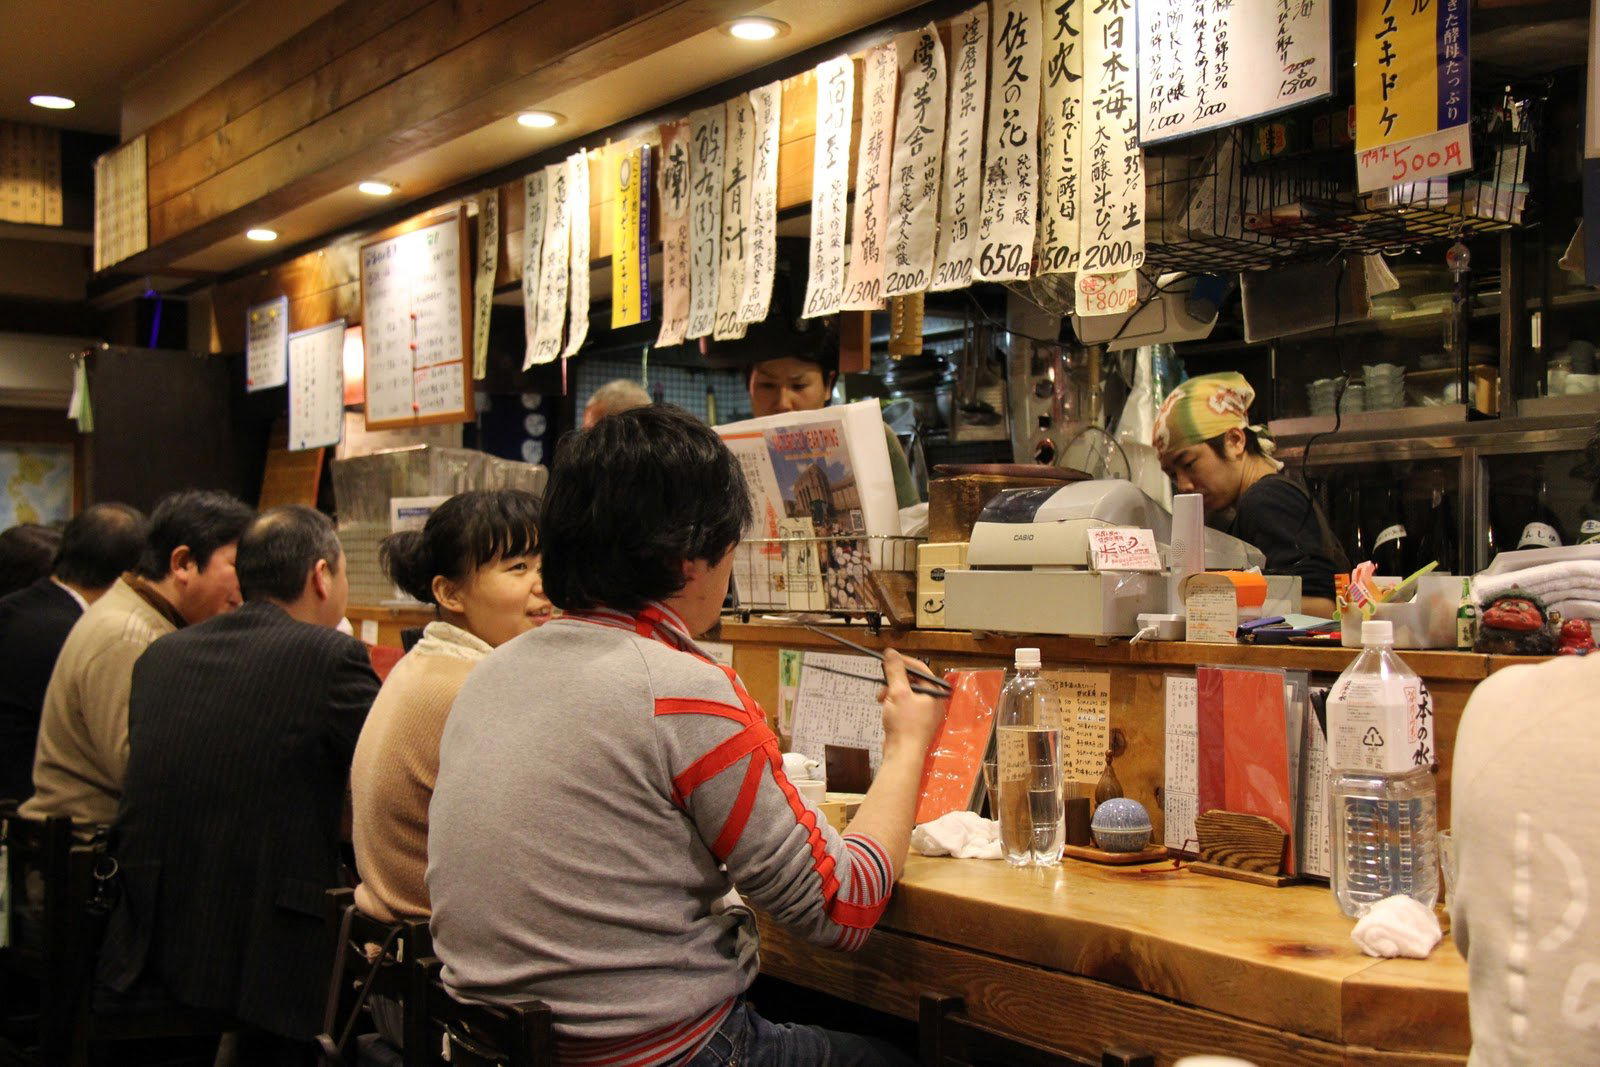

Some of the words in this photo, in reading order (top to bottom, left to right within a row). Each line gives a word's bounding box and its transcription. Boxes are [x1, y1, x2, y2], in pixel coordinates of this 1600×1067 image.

[997, 10, 1030, 148] 佐久の花
[1057, 97, 1081, 221] なでしこ酵母
[1391, 140, 1463, 182] 500円
[951, 129, 970, 244] 二十年古酒
[1012, 153, 1032, 226] 純米吟醸
[933, 257, 973, 287] 3000円
[979, 241, 1030, 277] 650円
[1082, 240, 1144, 270] 2000円
[1013, 534, 1035, 542] CASIO
